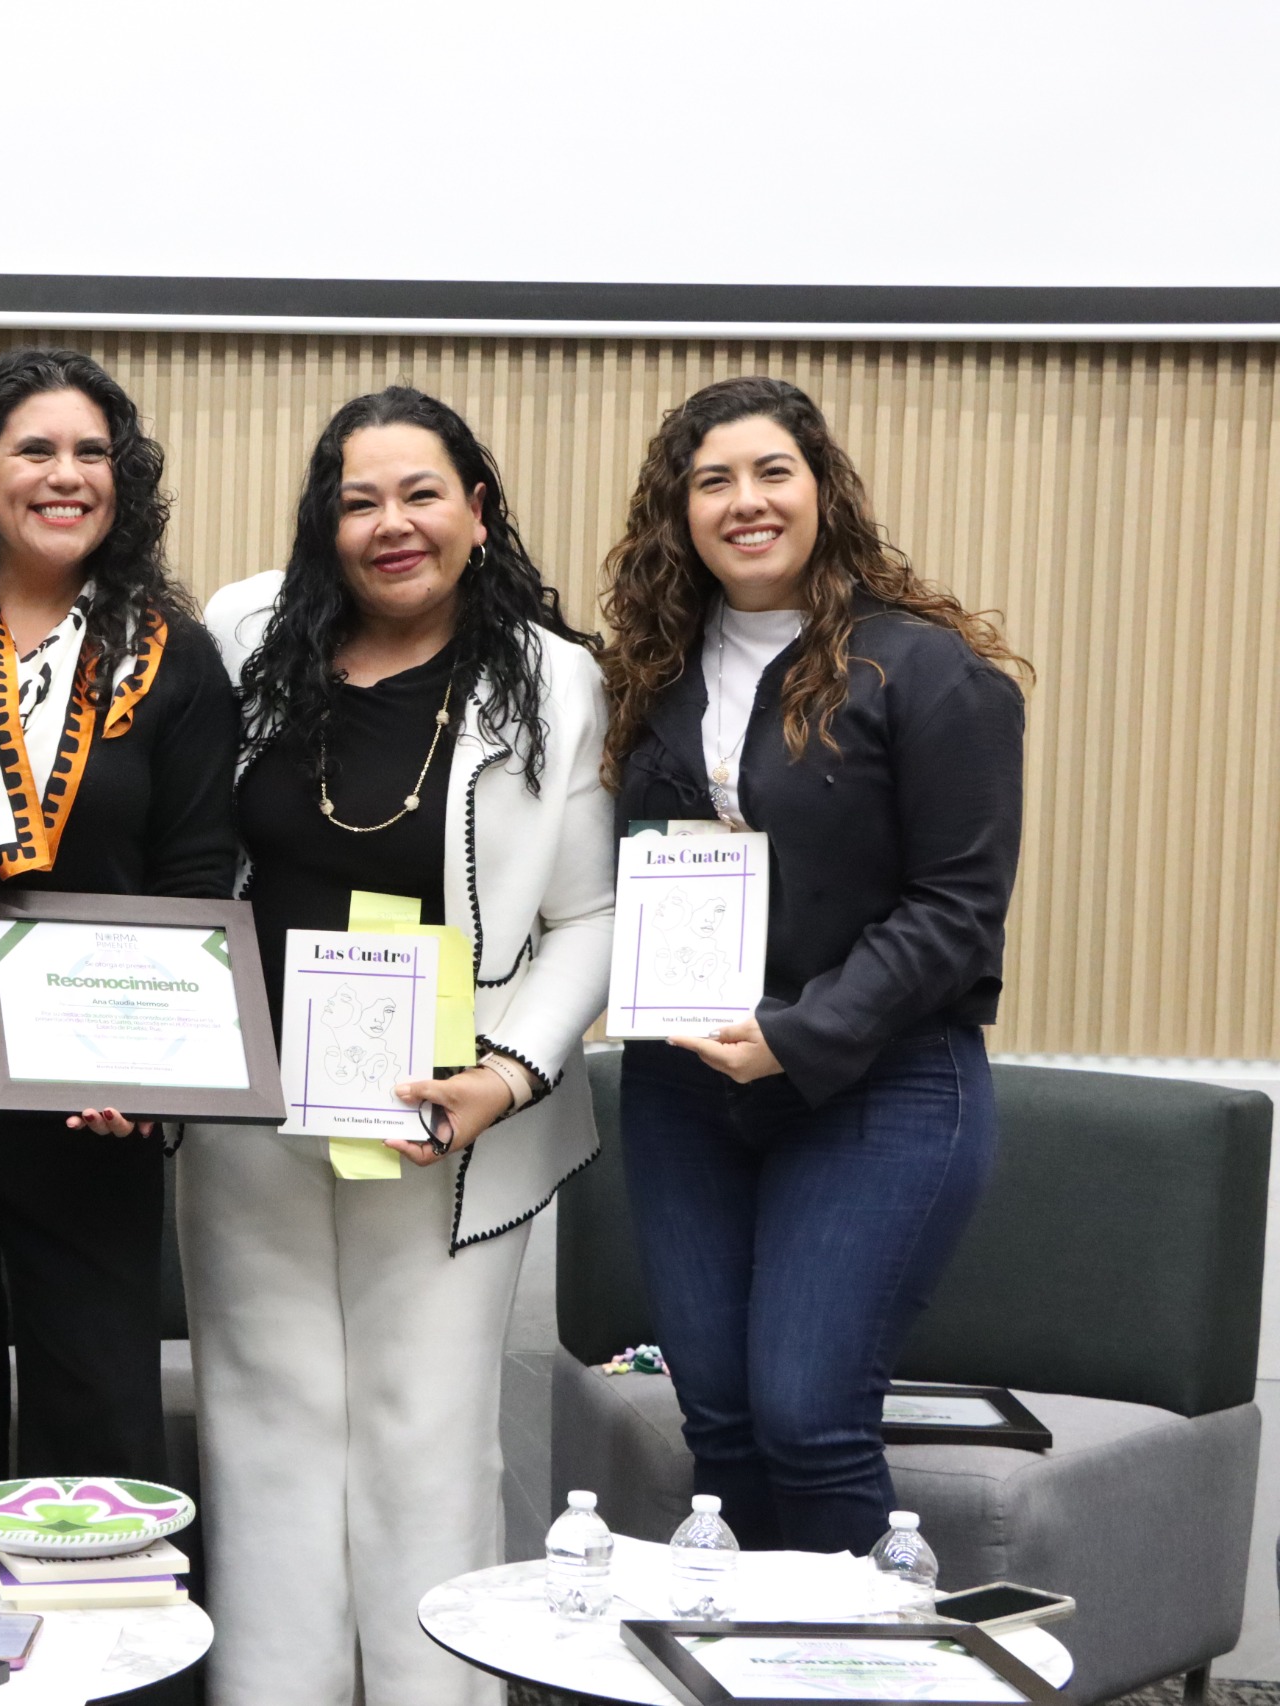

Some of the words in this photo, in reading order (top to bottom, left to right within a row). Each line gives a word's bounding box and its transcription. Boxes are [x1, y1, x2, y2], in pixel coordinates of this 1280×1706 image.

[646, 850, 675, 865] Las
[679, 849, 741, 865] Cuatro
[96, 941, 140, 950] PIMENTEL
[313, 944, 345, 961] Las
[348, 945, 411, 964] Cuatro
[46, 973, 199, 993] Reconocimiento
[108, 999, 135, 1007] Claudia
[136, 1000, 169, 1008] Hermoso
[332, 1115, 346, 1123] Ana
[346, 1115, 373, 1124] Claudia
[373, 1117, 405, 1126] Hermoso
[749, 1656, 938, 1667] Reconocimiento
